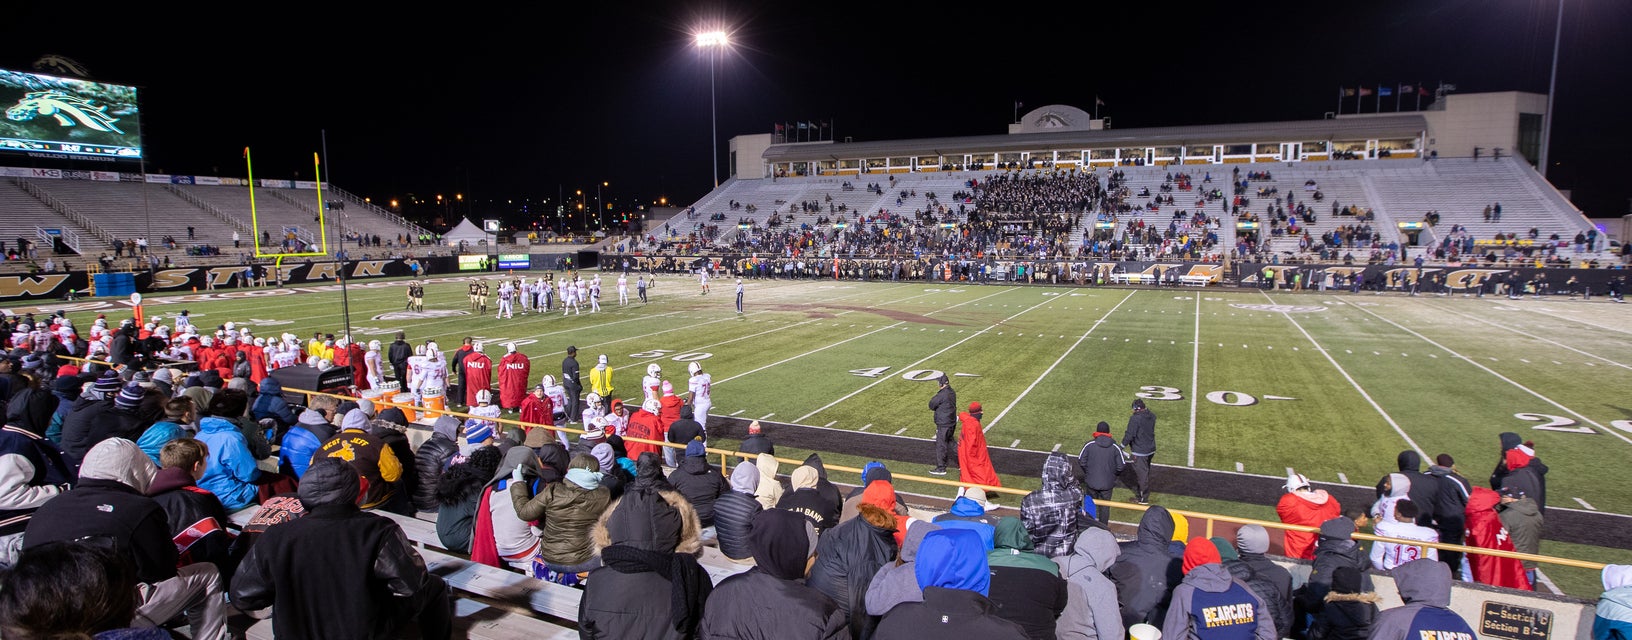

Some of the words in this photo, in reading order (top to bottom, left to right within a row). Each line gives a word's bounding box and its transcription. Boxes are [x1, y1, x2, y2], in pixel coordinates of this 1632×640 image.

[0, 259, 395, 298] WSTERN
[467, 361, 485, 369] NIU
[506, 361, 524, 370] NIU
[848, 366, 945, 381] 40
[1135, 385, 1256, 407] 30
[322, 437, 341, 451] WEST
[350, 437, 370, 447] JEFF
[795, 507, 824, 523] ALBANY
[1393, 545, 1418, 565] 13
[1202, 603, 1254, 623] BEARCATS
[1500, 609, 1536, 623] Section
[1206, 619, 1234, 628] BATTLE
[1235, 616, 1254, 625] CREEK
[1484, 620, 1519, 634] Section
[1522, 626, 1531, 635] B
